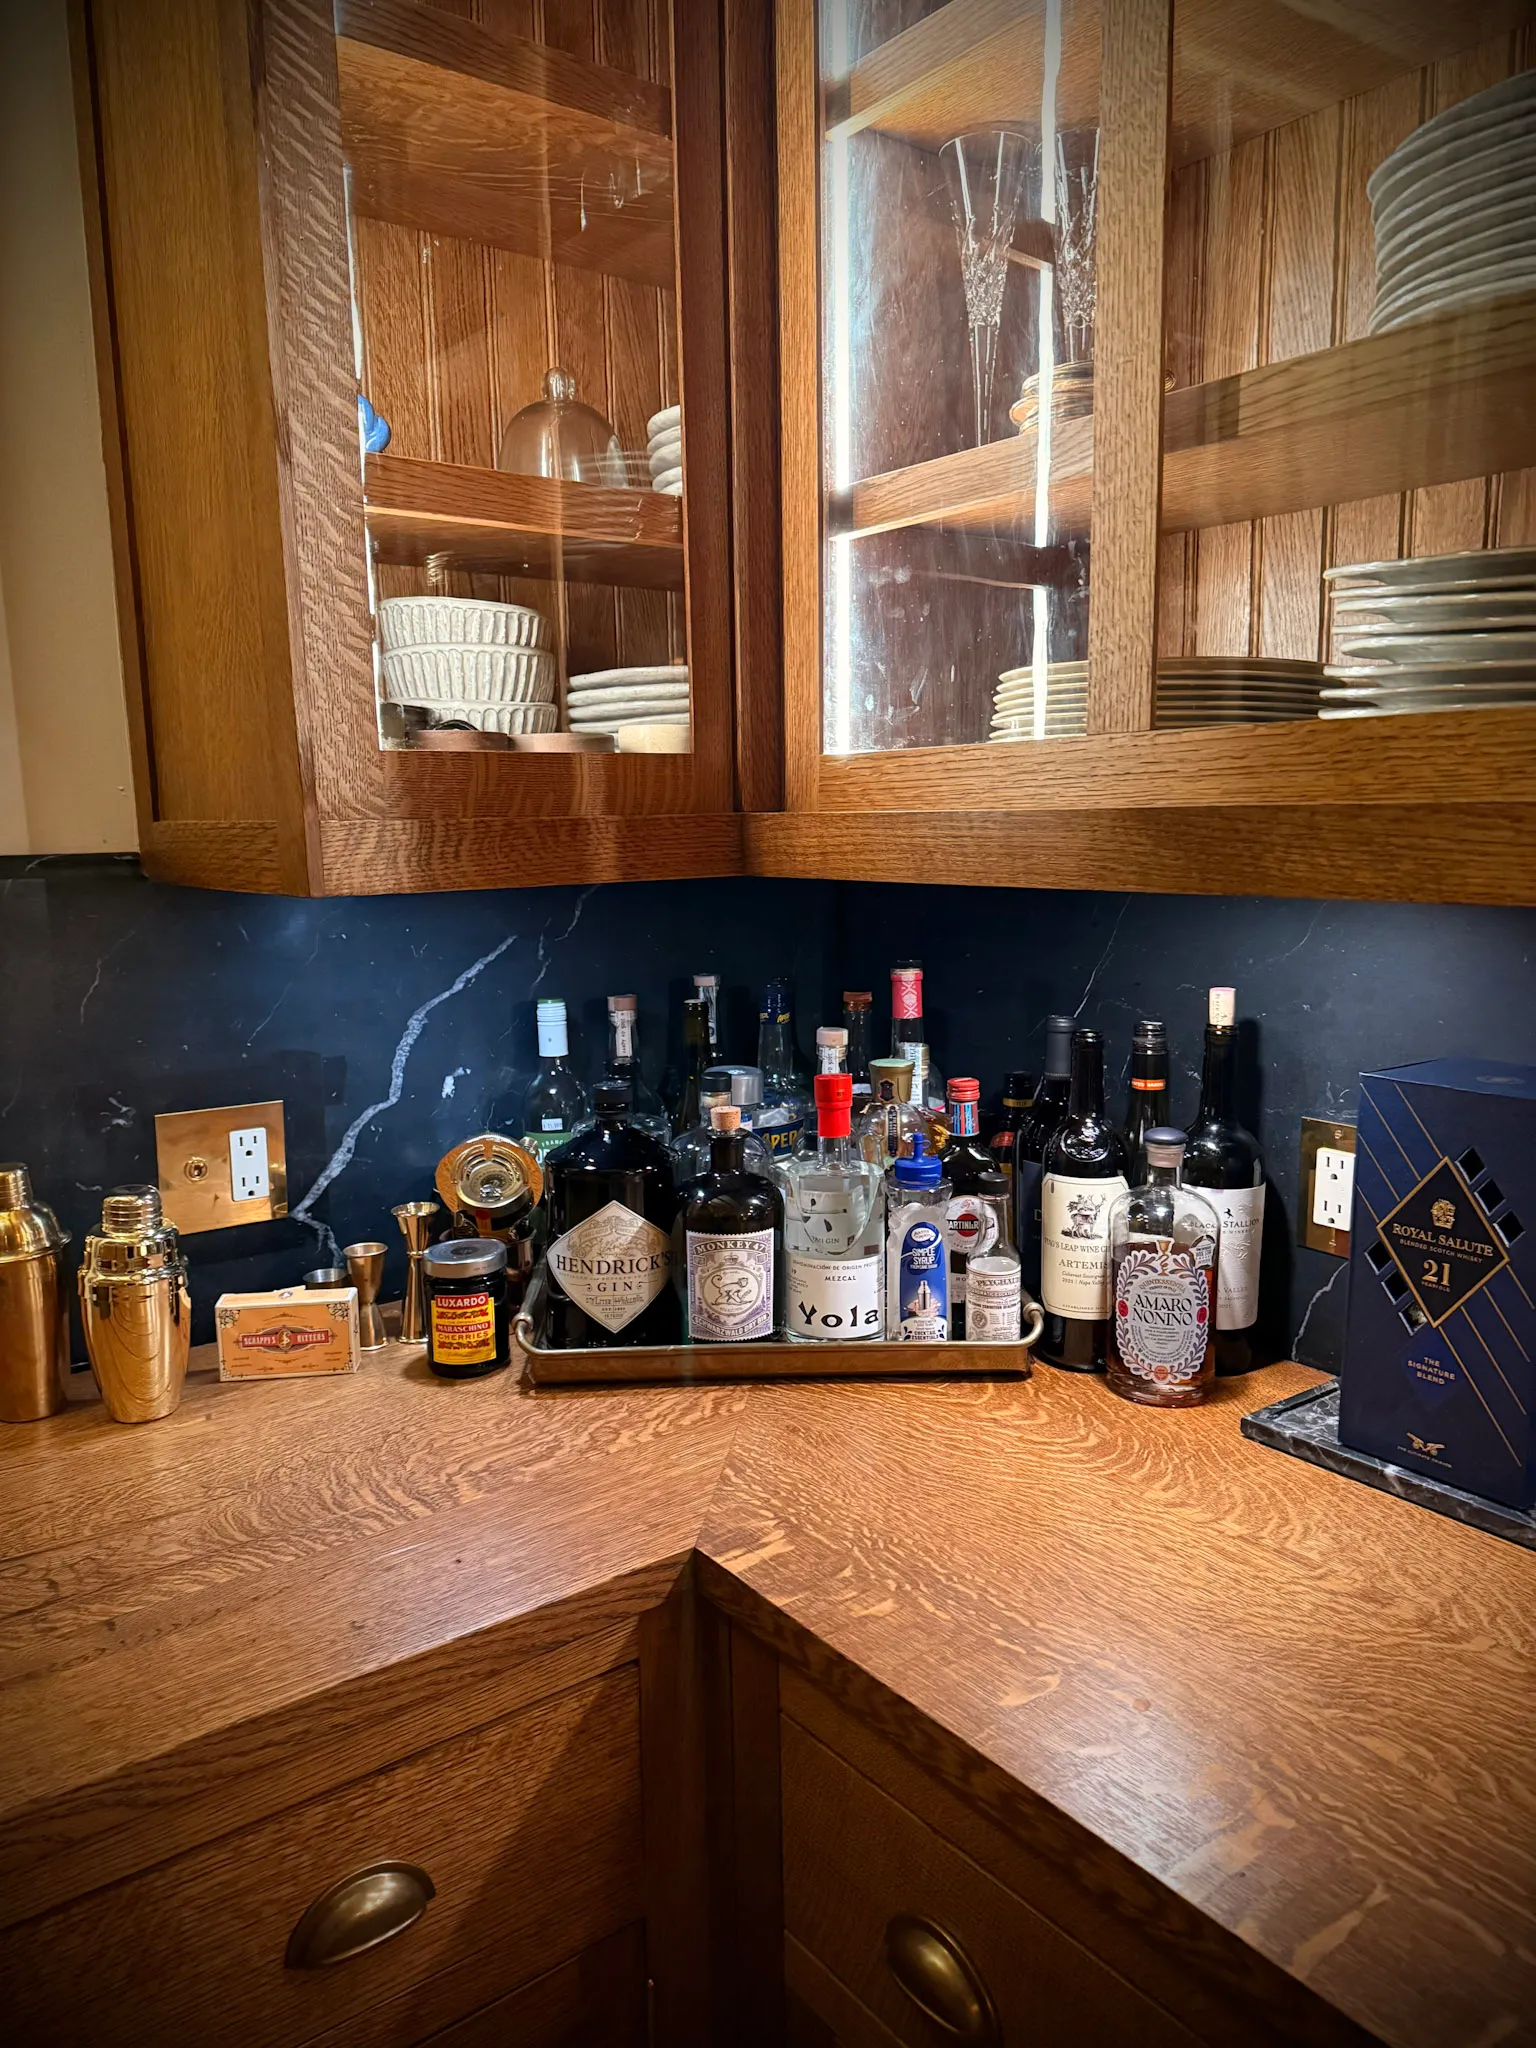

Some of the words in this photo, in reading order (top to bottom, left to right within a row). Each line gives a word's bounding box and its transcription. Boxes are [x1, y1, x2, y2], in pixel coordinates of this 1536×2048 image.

[1223, 1218, 1260, 1229] STALLION
[1392, 1223, 1436, 1243] ROYAL
[1438, 1235, 1494, 1257] SALUTE
[696, 1240, 752, 1254] MONKEY
[752, 1243, 766, 1252] 47
[912, 1247, 936, 1257] SIMPLE
[1061, 1243, 1079, 1253] LEAP
[1080, 1245, 1100, 1253] WINE
[1400, 1239, 1428, 1250] BLENDED
[1430, 1246, 1455, 1257] SCOTCH
[556, 1250, 671, 1275] HENDRICK'S
[913, 1256, 935, 1265] SYRUP
[1058, 1259, 1110, 1270] ARTEMIS
[841, 1263, 863, 1271] ORIGEN
[1422, 1259, 1451, 1286] 21
[597, 1281, 634, 1292] GIN
[437, 1295, 487, 1308] LUXARDO
[1133, 1294, 1193, 1312] AMARO
[798, 1301, 879, 1328] Yola
[1132, 1308, 1193, 1326] NONINO
[437, 1321, 489, 1332] MARASCHINO
[744, 1320, 757, 1332] DRY
[438, 1330, 489, 1341] CHERRIES
[1423, 1357, 1440, 1367] THE
[1407, 1360, 1455, 1380] SIGNATURE
[1416, 1371, 1446, 1385] BLEND
